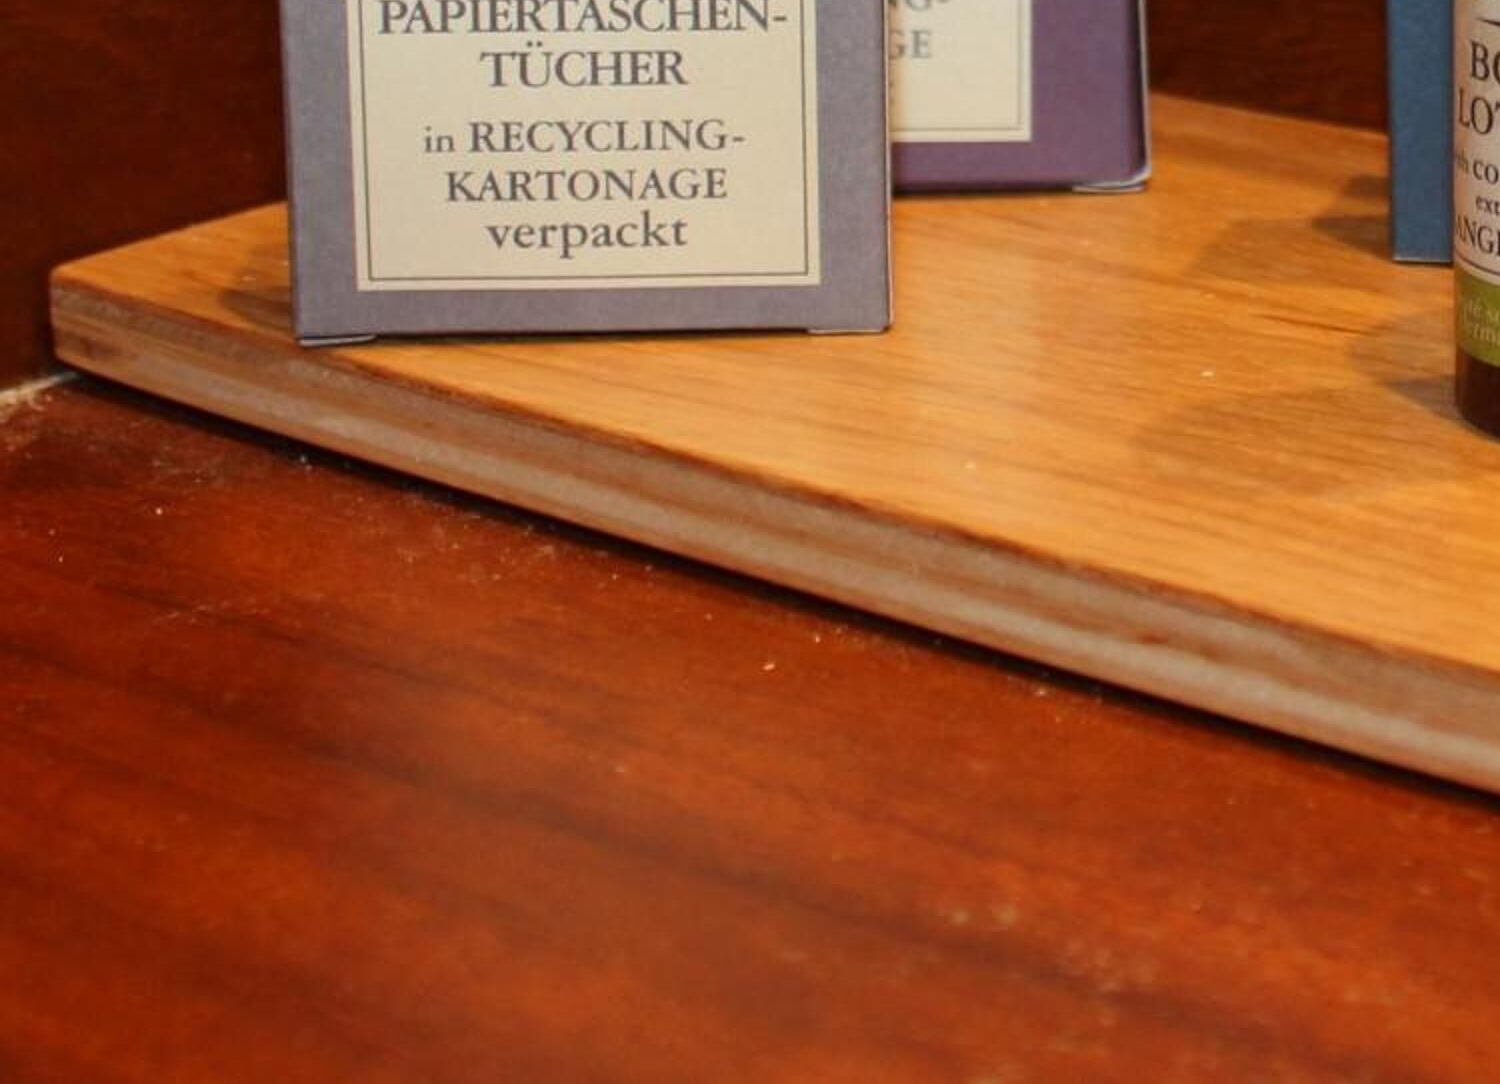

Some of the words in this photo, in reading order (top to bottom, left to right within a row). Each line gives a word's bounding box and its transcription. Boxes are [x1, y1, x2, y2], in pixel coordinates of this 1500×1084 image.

[480, 43, 688, 88] TÜCHER
[424, 127, 454, 153] in
[469, 119, 746, 153] RECYCLING-
[445, 168, 727, 202] KARTONAGE
[486, 210, 688, 258] verpackt
